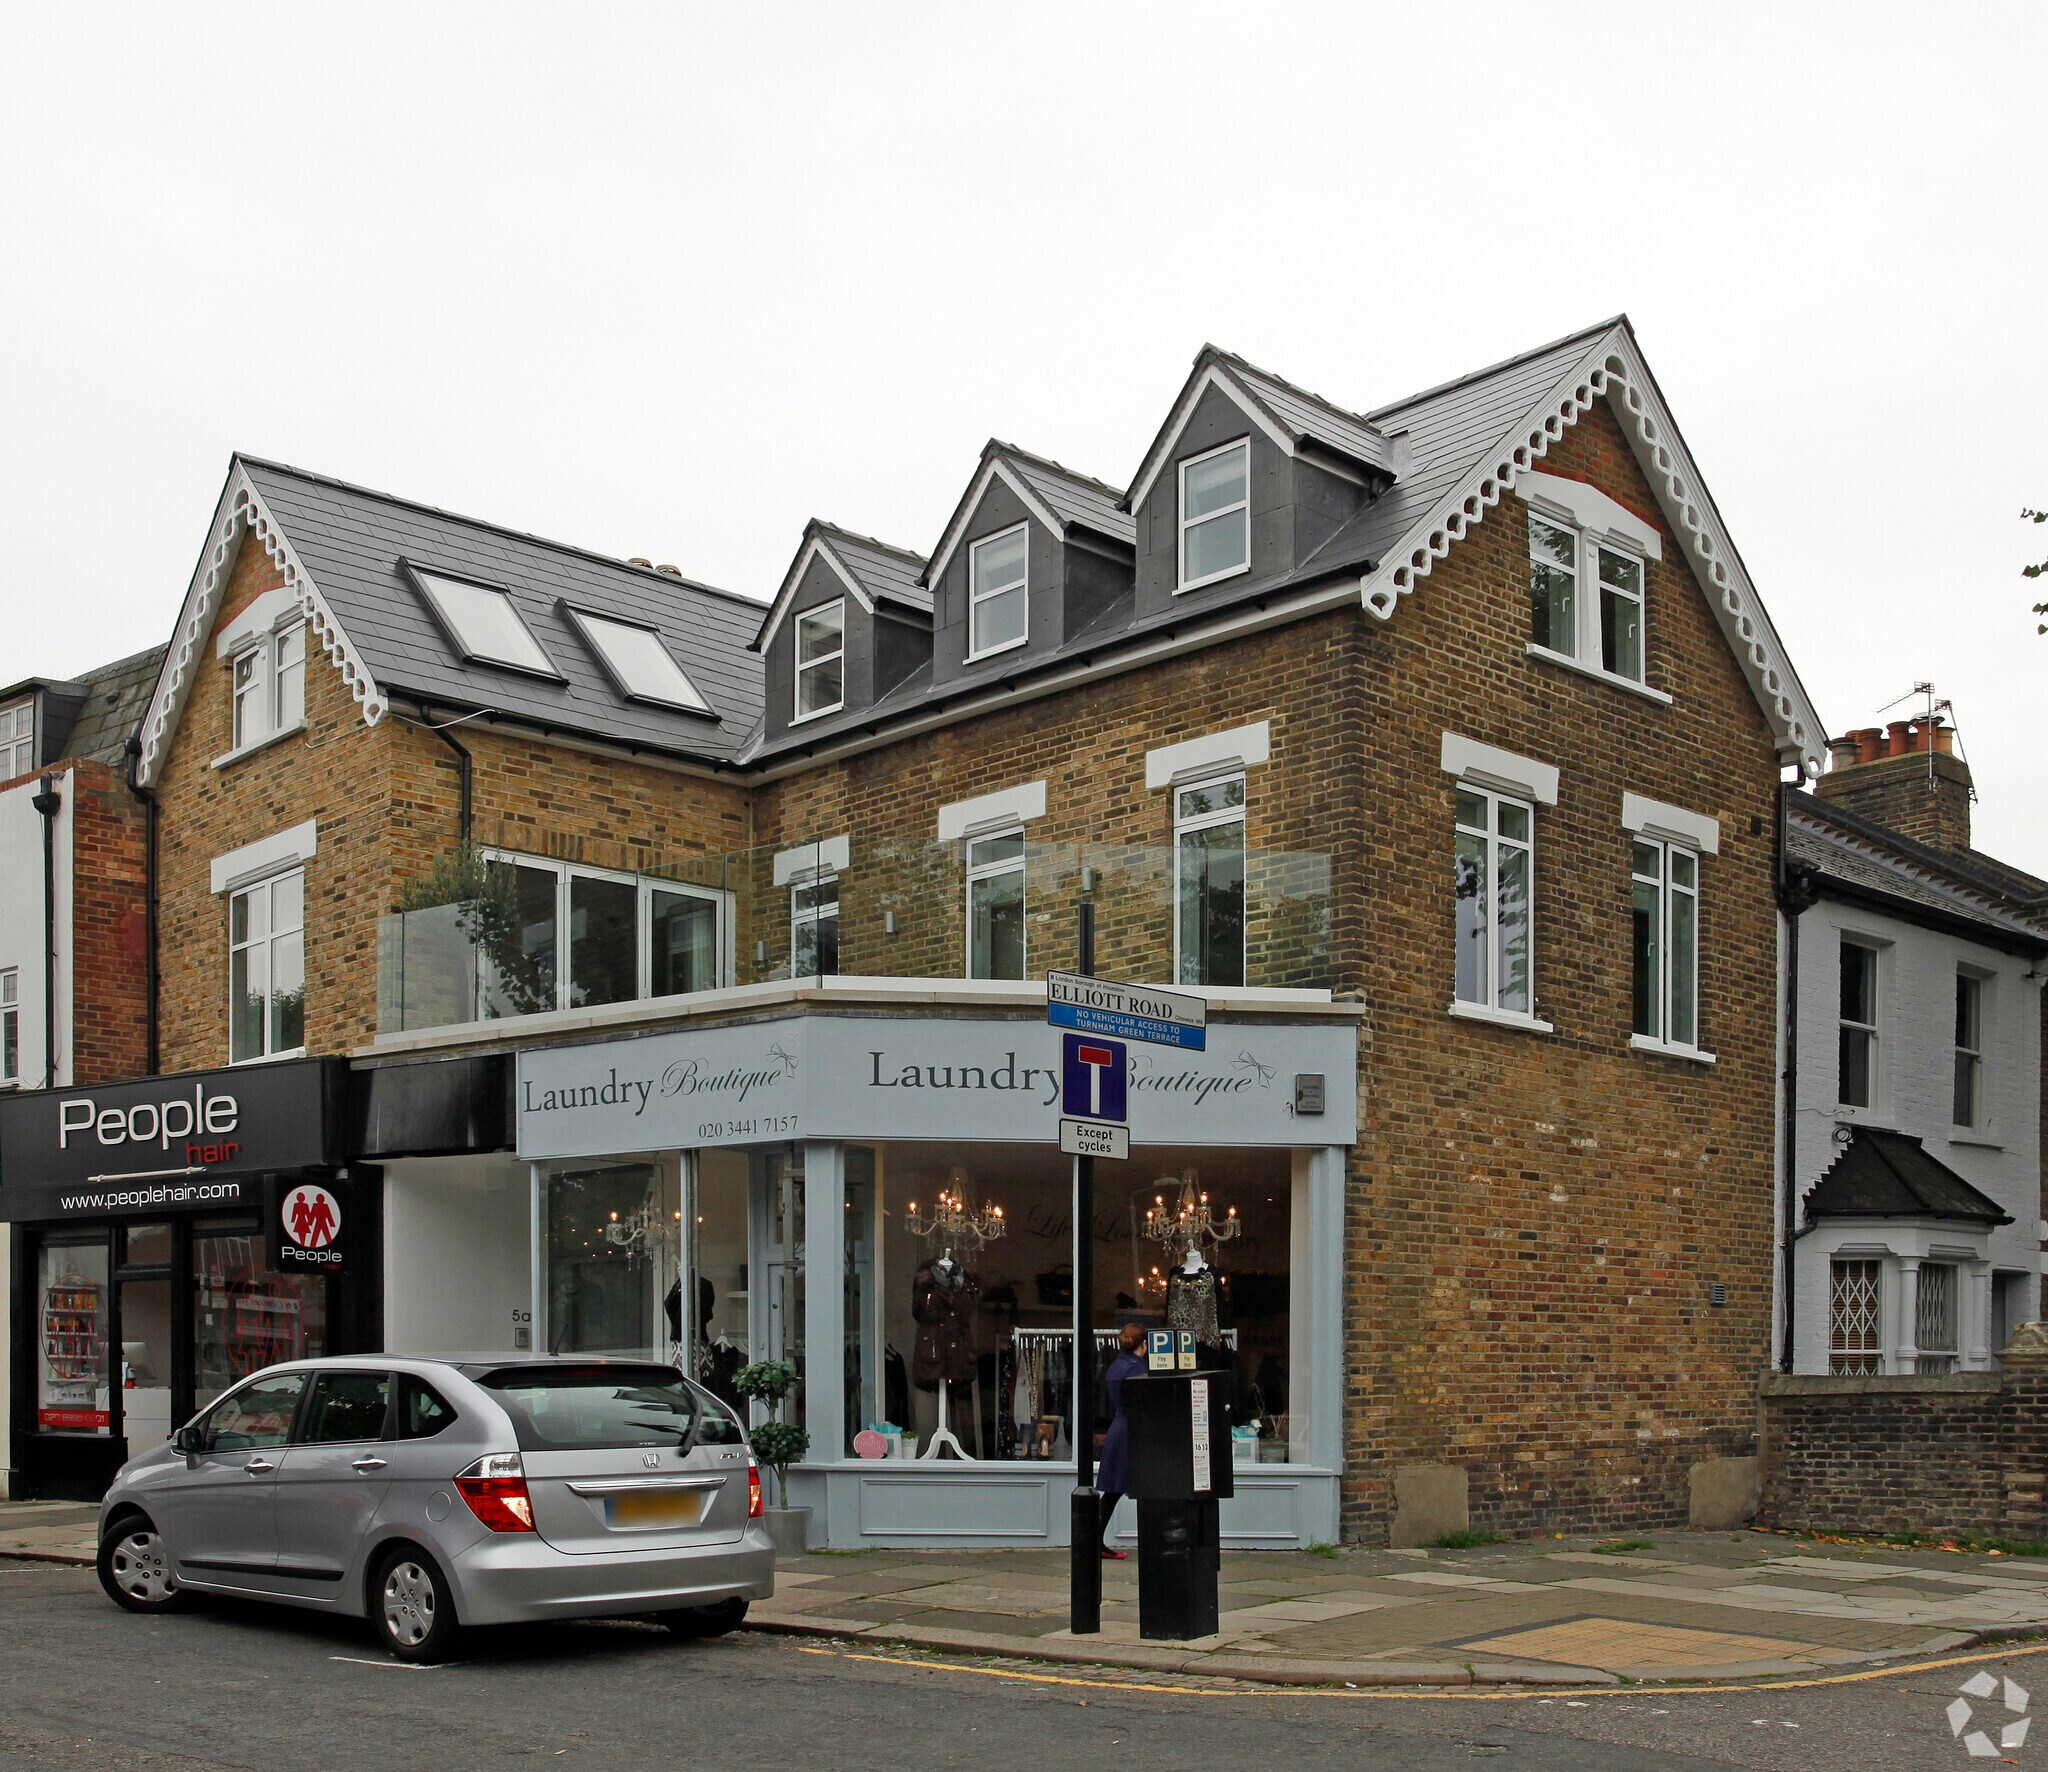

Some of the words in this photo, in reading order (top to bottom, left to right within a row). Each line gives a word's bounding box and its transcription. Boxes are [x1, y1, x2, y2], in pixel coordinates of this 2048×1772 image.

[1050, 983, 1125, 1011] ELLIOTT
[1129, 997, 1173, 1019] ROAD
[1076, 1009, 1089, 1018] NO
[1091, 1012, 1135, 1027] VEHICULAR
[1137, 1020, 1168, 1032] ACCESS
[1170, 1026, 1180, 1034] TO
[1076, 1018, 1116, 1033] TURNHAM
[1118, 1026, 1145, 1038] GREEN
[1147, 1031, 1180, 1044] TERRACE
[523, 1067, 654, 1117] Laundry
[660, 1057, 782, 1103] Boutique
[868, 1050, 1060, 1106] Laundry
[59, 1083, 238, 1150] People
[698, 1122, 723, 1139] 020
[727, 1119, 758, 1137] 3441
[764, 1115, 798, 1134] 7157
[1077, 1125, 1113, 1141] Except
[185, 1138, 240, 1164] hair
[1078, 1140, 1112, 1153] cycles
[60, 1183, 240, 1210] www.peoplehair.com
[281, 1246, 342, 1264] People
[512, 1309, 531, 1322] 5a
[1153, 1332, 1169, 1353] P
[1181, 1332, 1192, 1353] P
